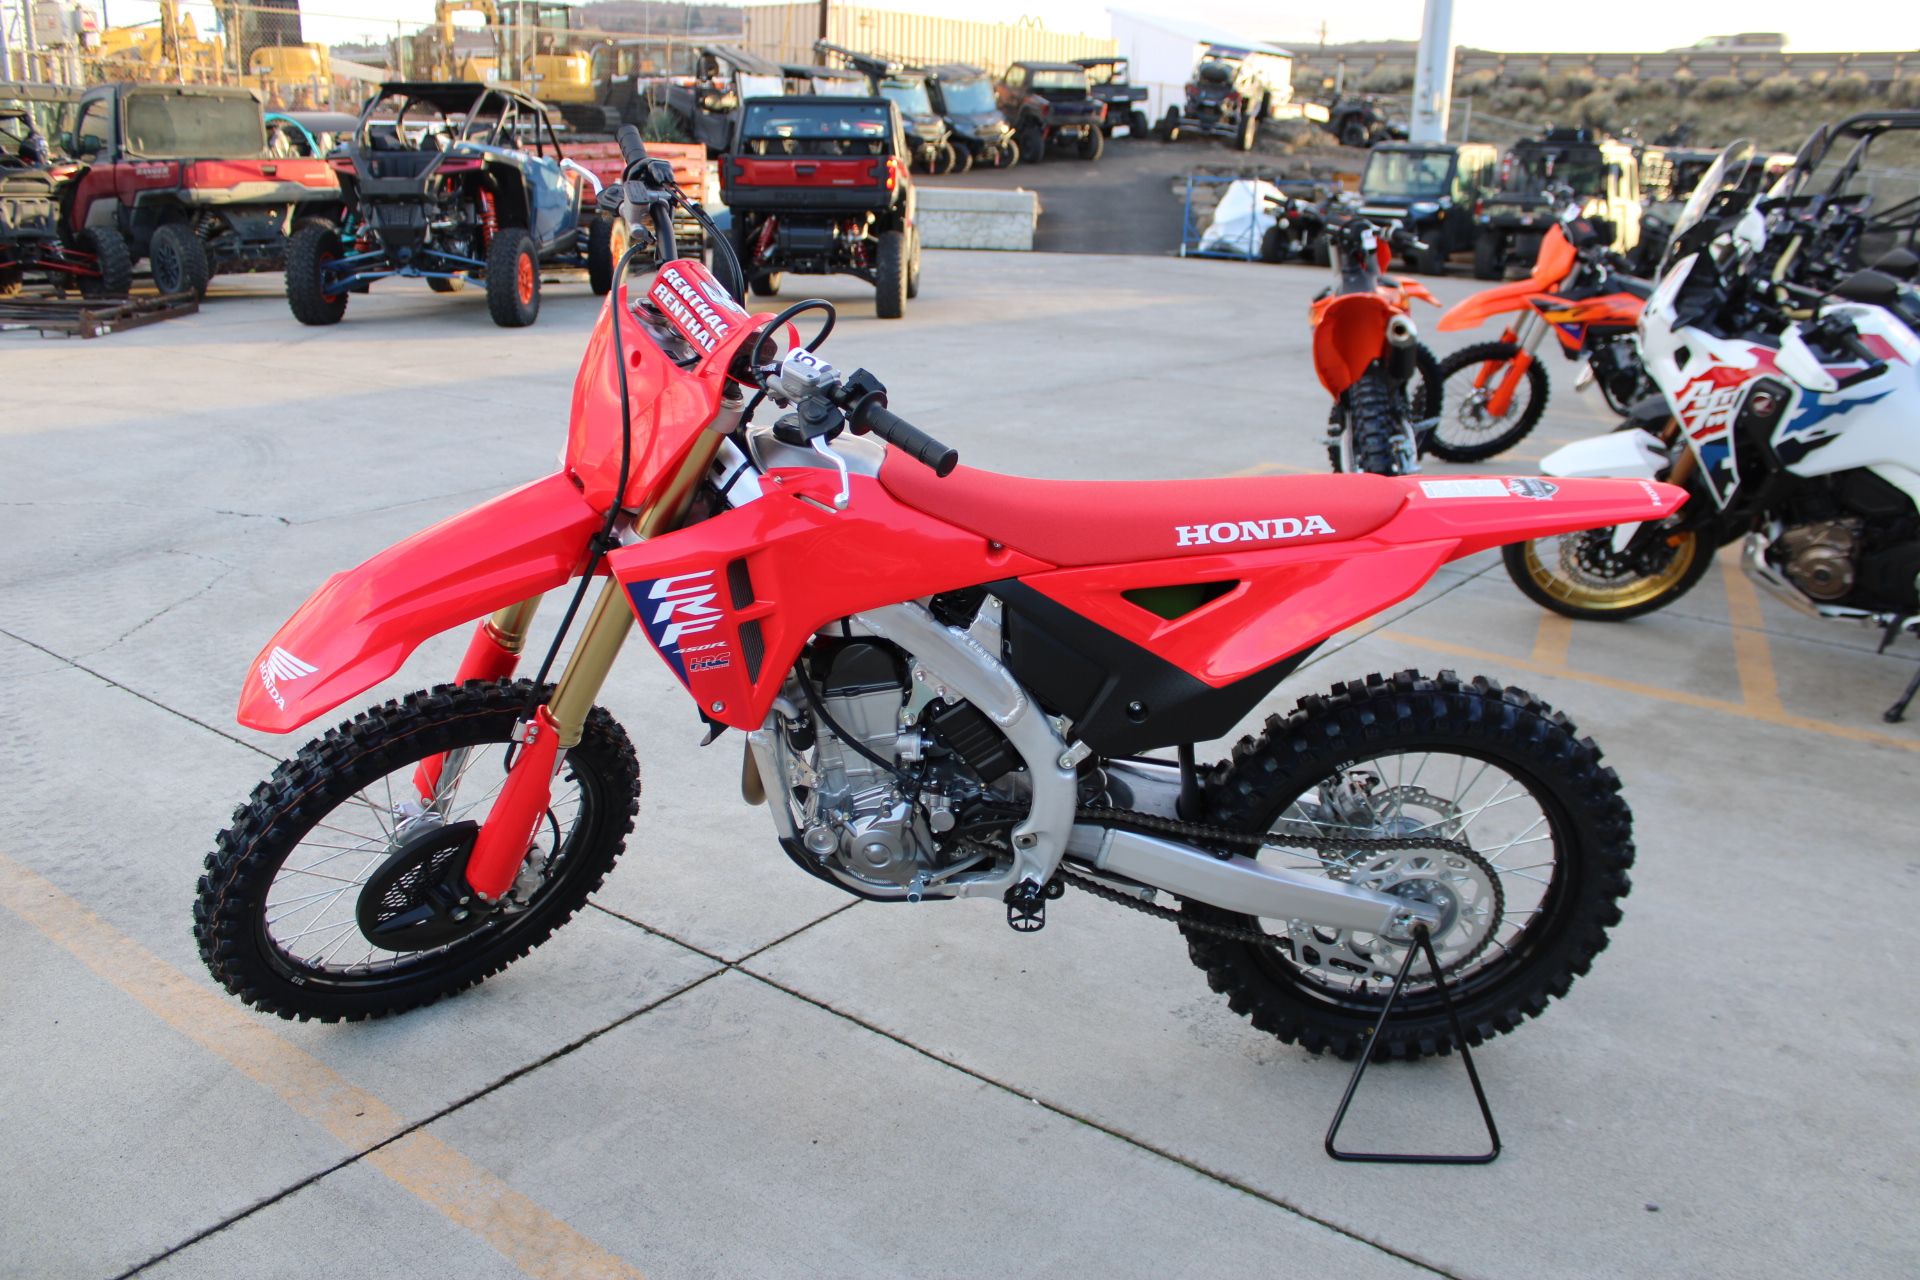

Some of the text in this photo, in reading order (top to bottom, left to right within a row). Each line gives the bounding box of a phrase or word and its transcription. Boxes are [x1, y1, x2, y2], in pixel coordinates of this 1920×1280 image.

[653, 283, 718, 352] RENTHAL
[662, 268, 729, 338] RENTHAL
[1175, 514, 1336, 546] HONDA
[648, 569, 725, 647] CRF
[672, 641, 728, 653] 450R
[690, 652, 730, 670] HRC
[259, 660, 285, 711] HONDA
